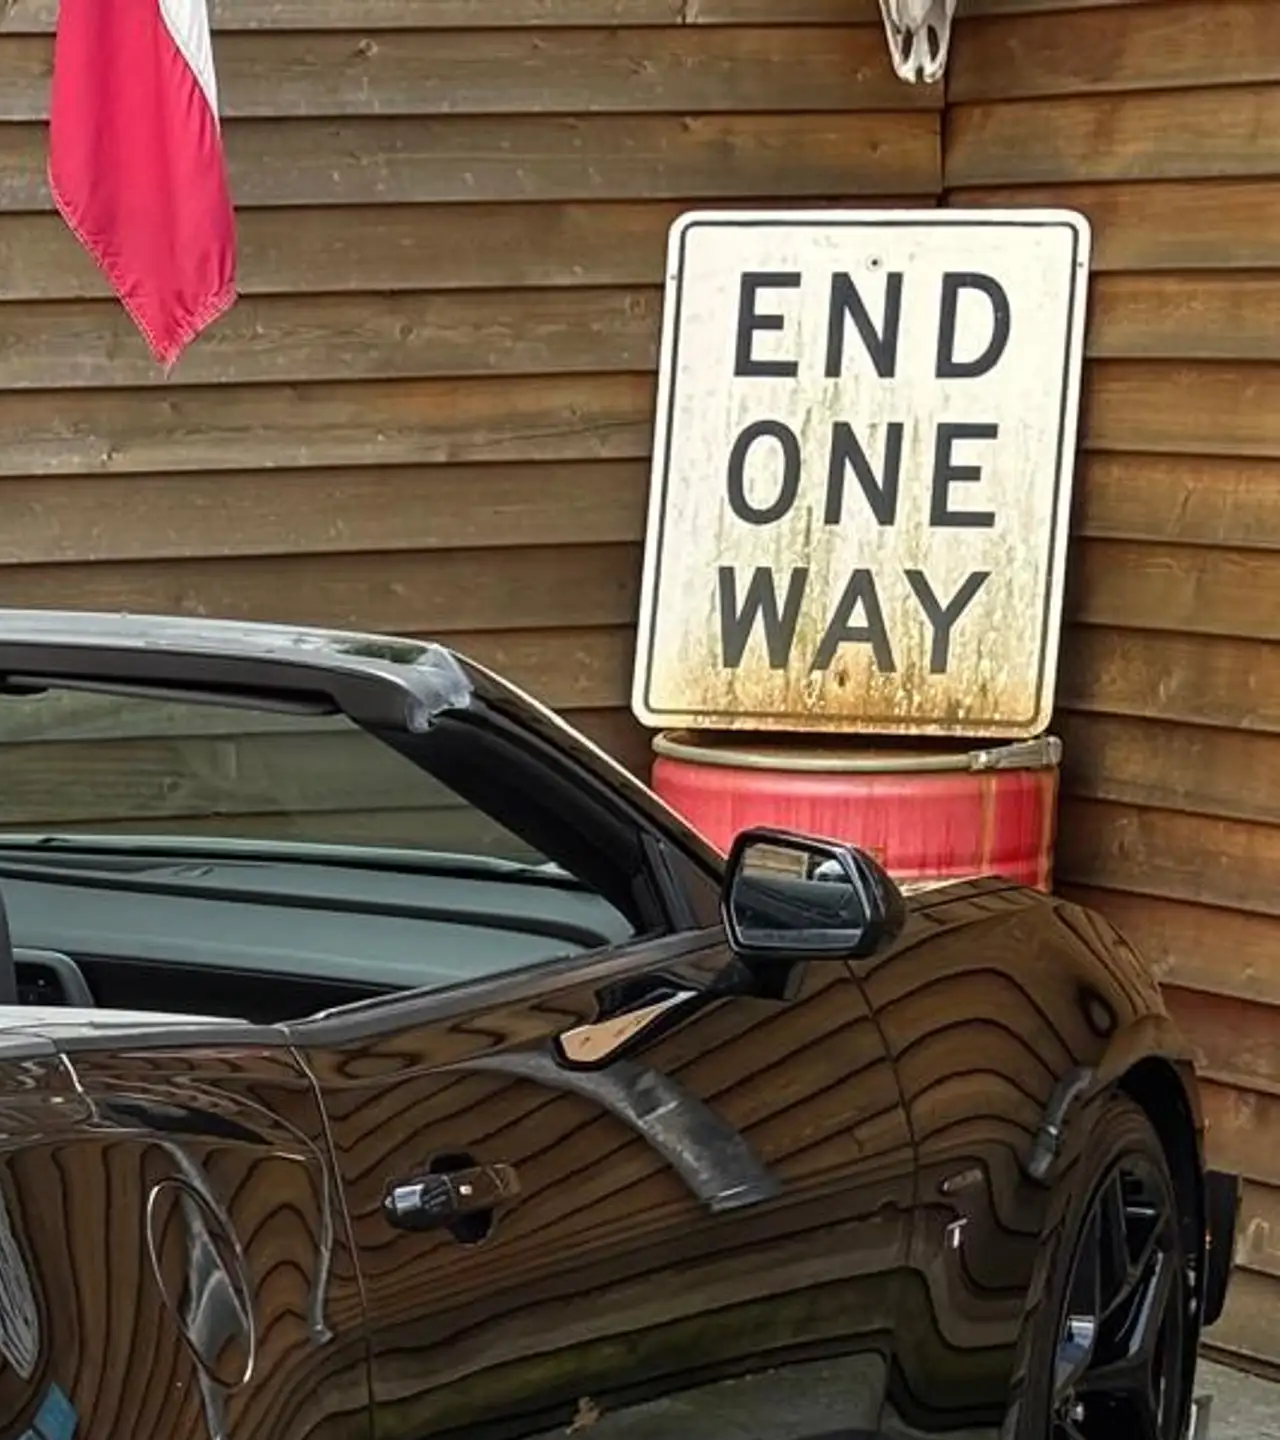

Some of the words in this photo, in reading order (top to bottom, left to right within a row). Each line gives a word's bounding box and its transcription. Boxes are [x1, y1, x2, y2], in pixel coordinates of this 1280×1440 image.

[733, 271, 1013, 379] END
[725, 419, 999, 529] ONE
[717, 565, 992, 675] WAY
